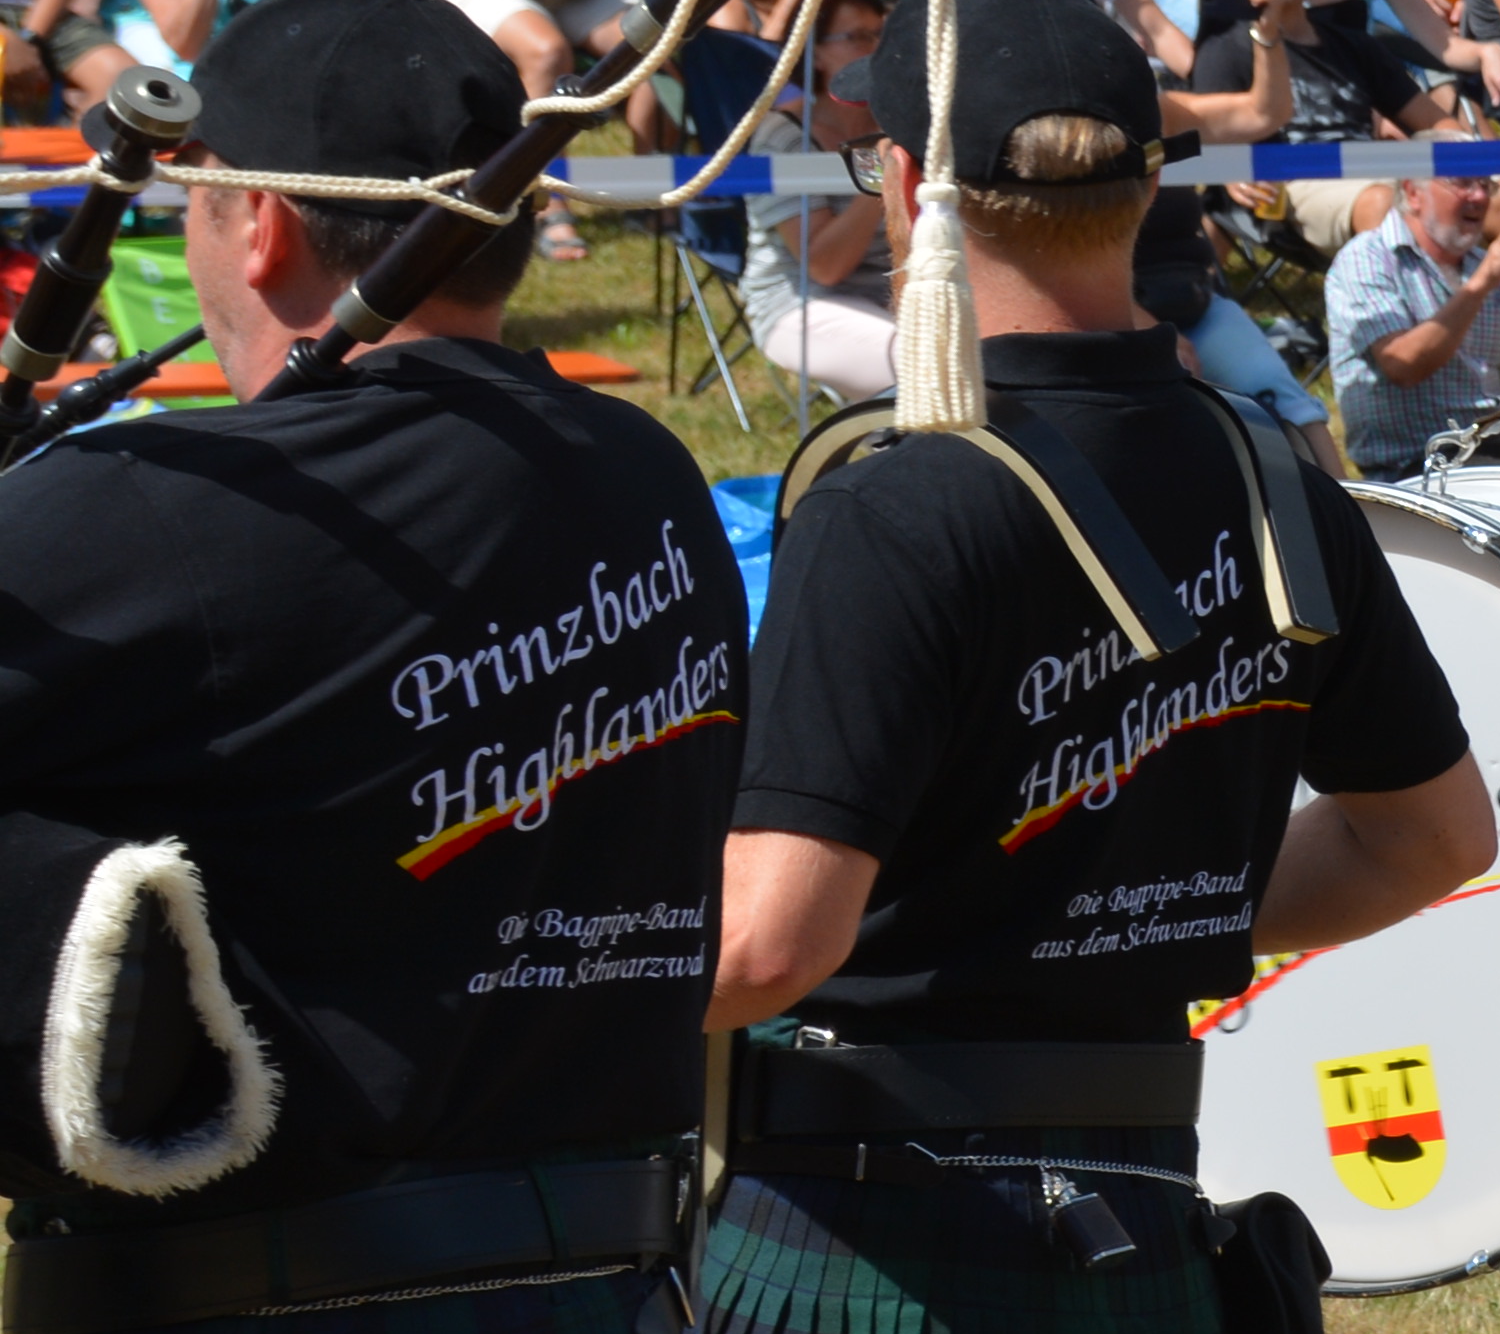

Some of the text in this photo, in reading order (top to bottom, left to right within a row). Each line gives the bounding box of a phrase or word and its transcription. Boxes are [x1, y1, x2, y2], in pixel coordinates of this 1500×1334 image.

[391, 519, 695, 732] Prinzbach
[1017, 530, 1244, 727] Princh
[411, 637, 729, 843] Highlanders
[1013, 637, 1291, 827] Highlanders
[500, 954, 566, 988] dem
[1031, 900, 1253, 960] aus dem Schwarzwald
[1066, 862, 1250, 918] Die Bagpipe-Band
